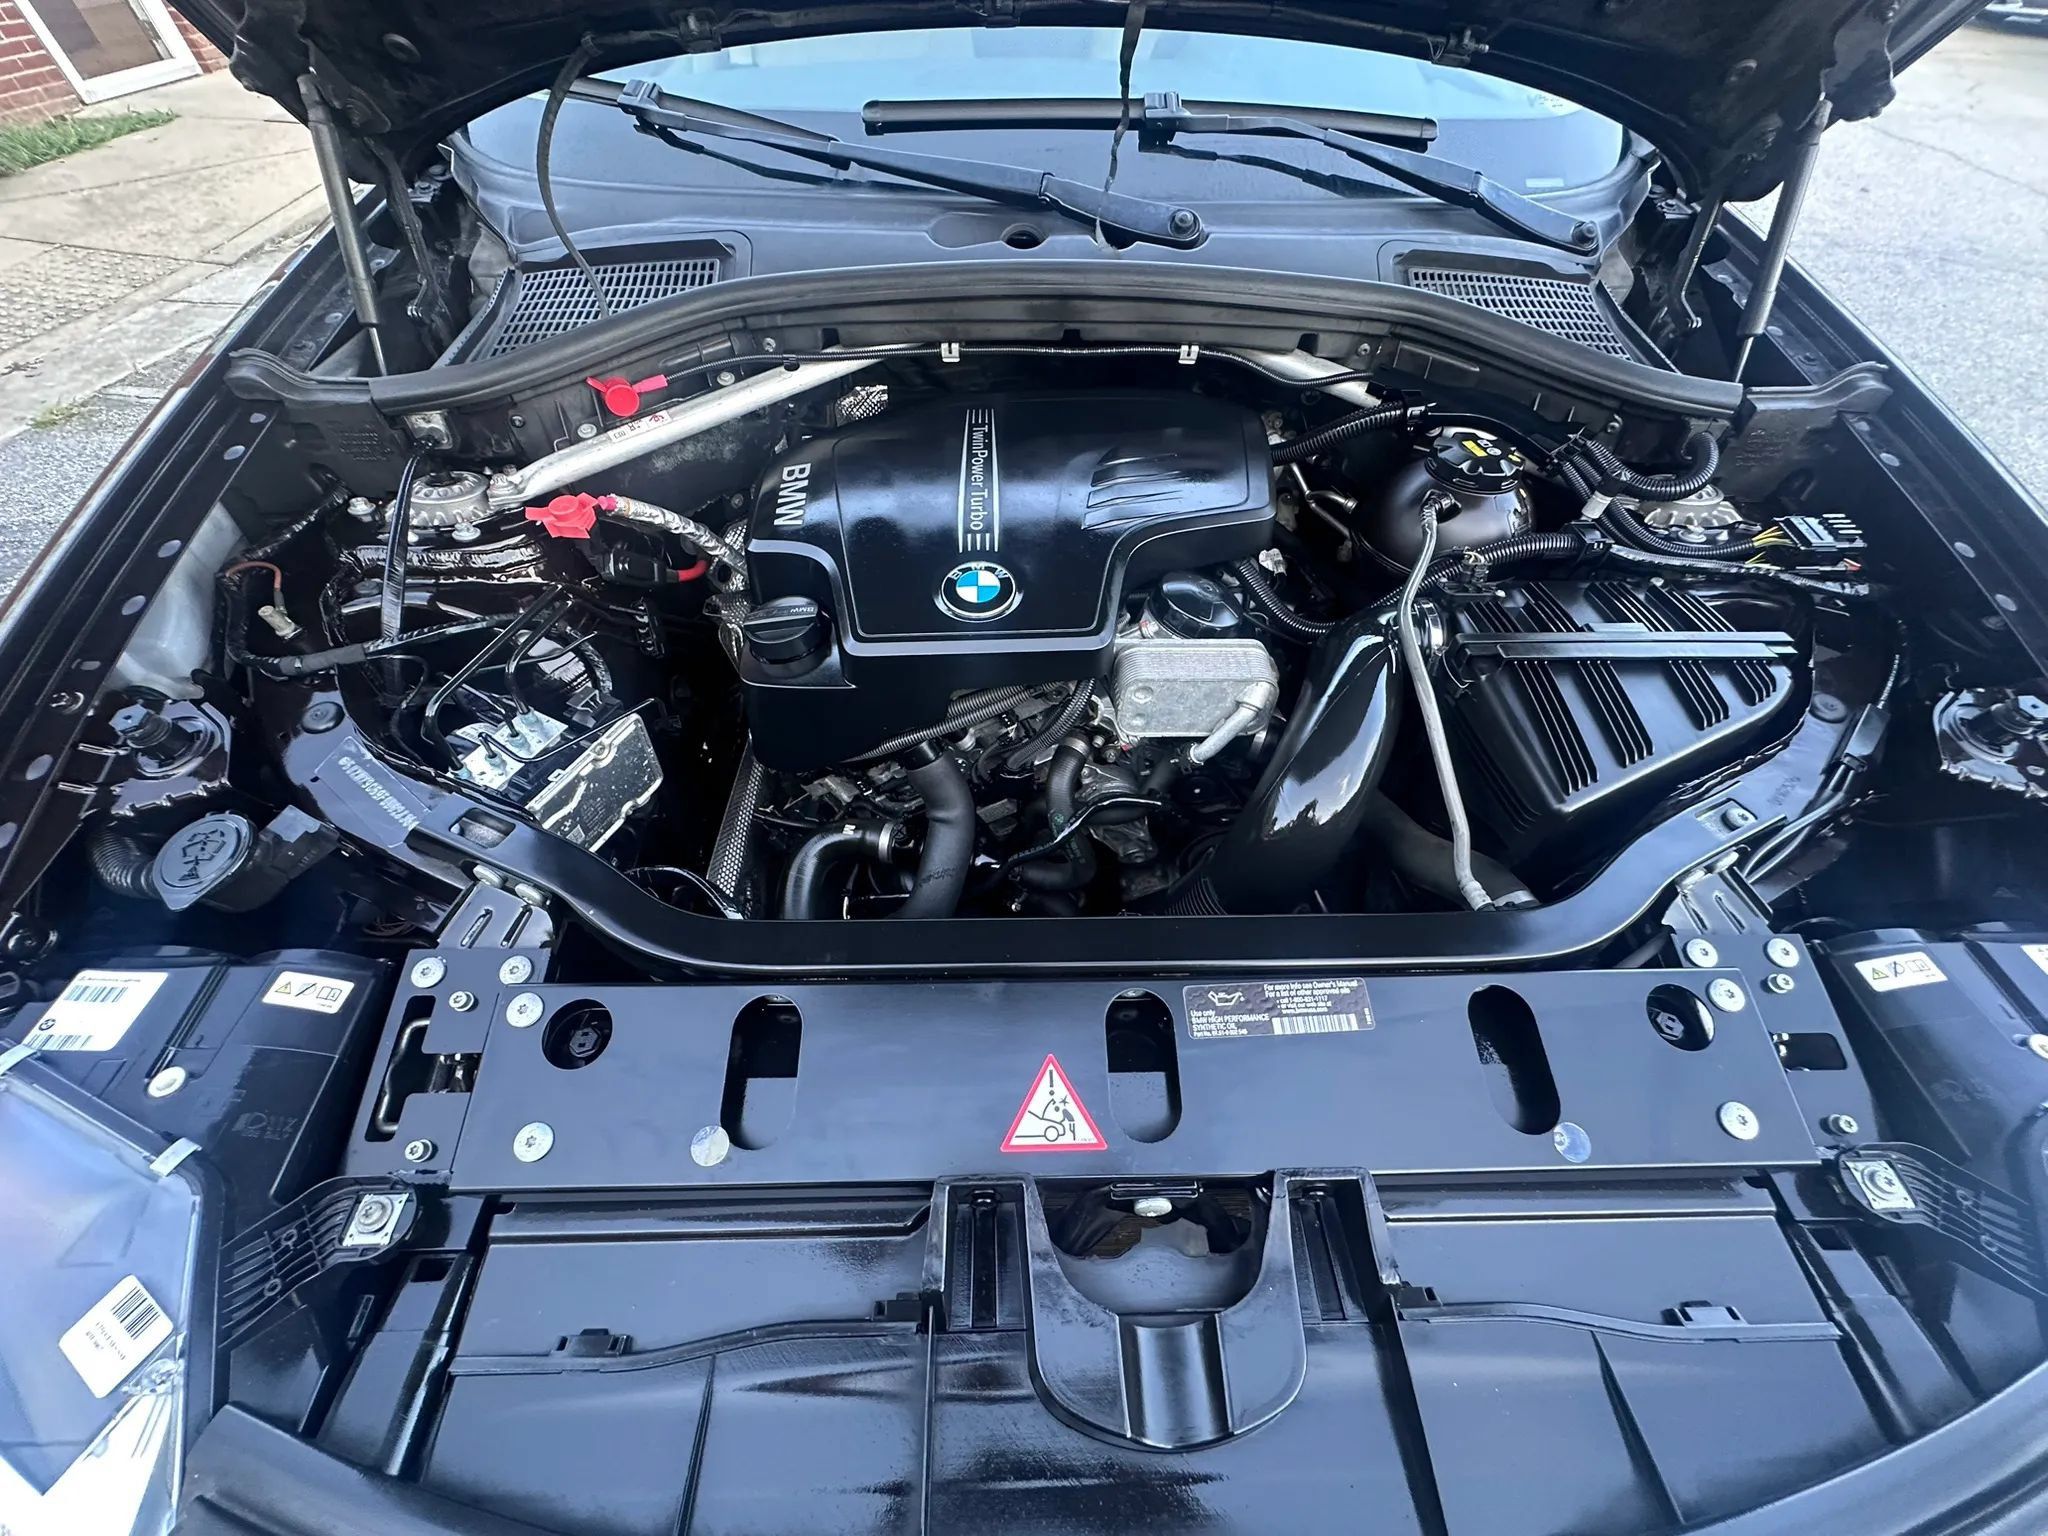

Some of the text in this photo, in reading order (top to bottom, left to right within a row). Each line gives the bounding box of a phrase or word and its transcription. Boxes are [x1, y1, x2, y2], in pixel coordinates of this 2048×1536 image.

[970, 424, 989, 531] TwinPower Turbo
[773, 463, 812, 526] BMW
[790, 606, 815, 614] BMW
[1264, 983, 1274, 991] For
[1275, 983, 1290, 991] more
[1313, 981, 1337, 989] Owner's
[1265, 990, 1275, 998] For
[1312, 987, 1340, 996] approved
[1190, 1009, 1216, 1018] Use only
[1224, 1013, 1270, 1023] PERFORMANCE
[1192, 1022, 1238, 1032] SYNTHETIC OIL
